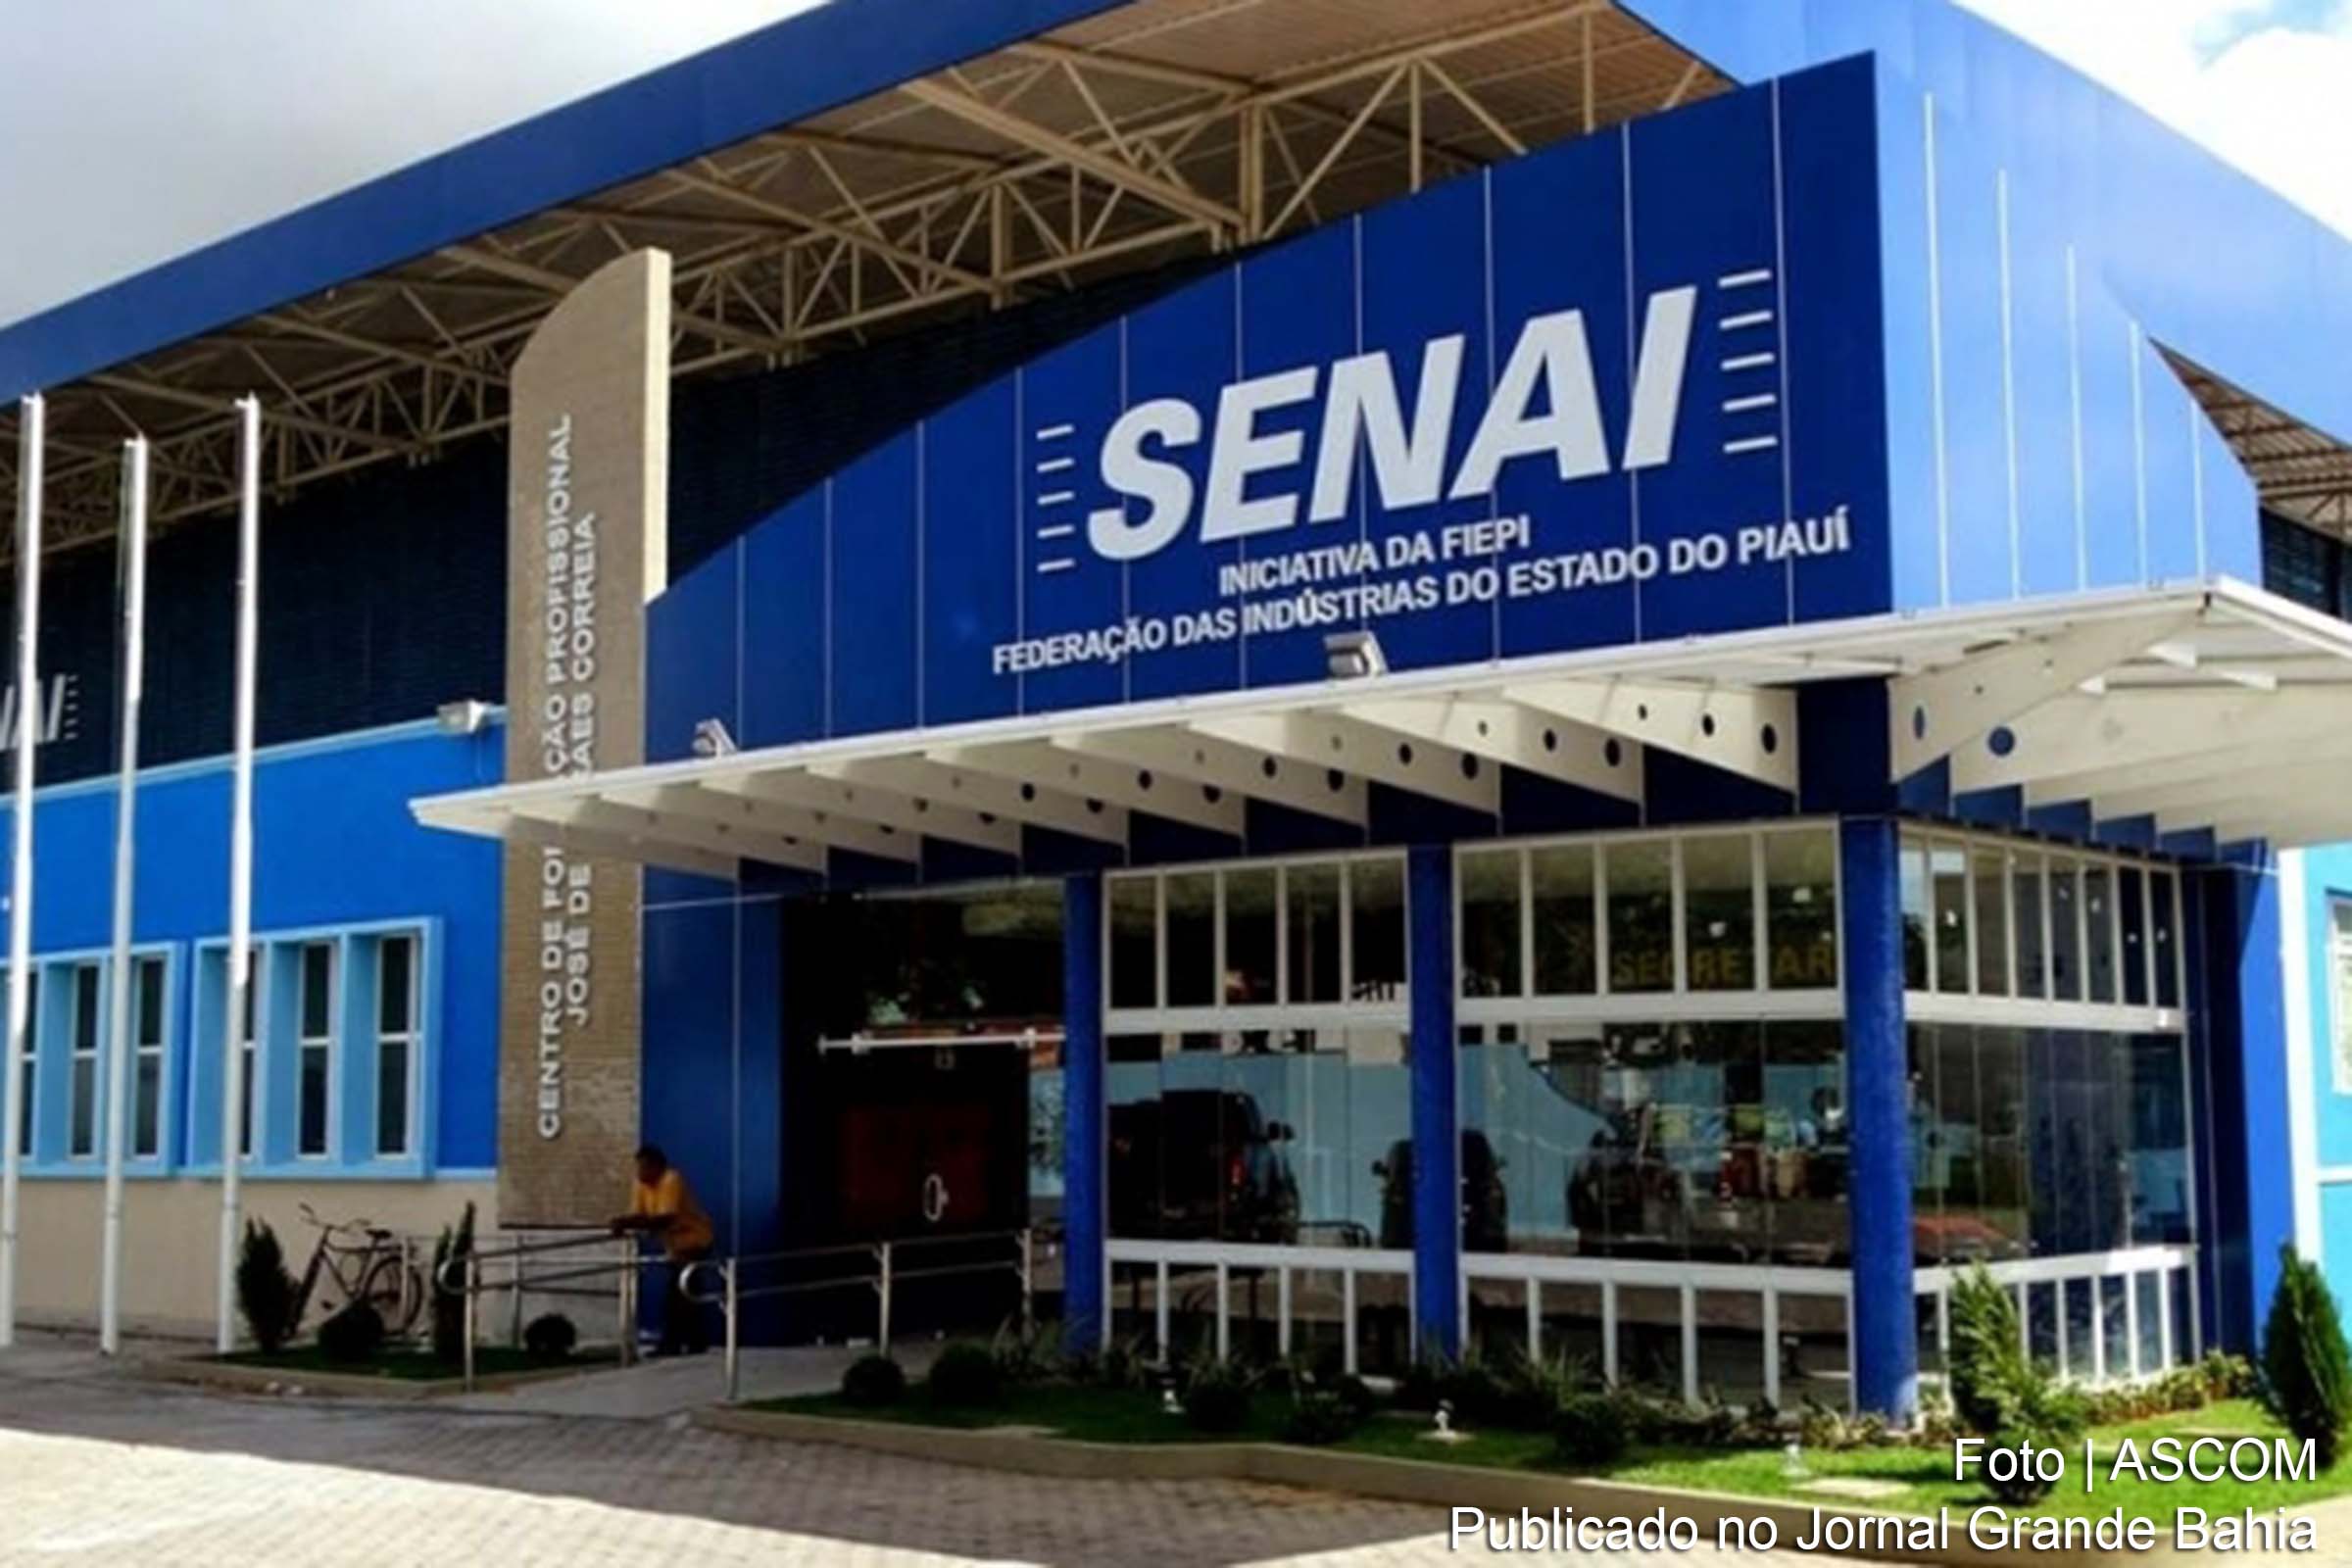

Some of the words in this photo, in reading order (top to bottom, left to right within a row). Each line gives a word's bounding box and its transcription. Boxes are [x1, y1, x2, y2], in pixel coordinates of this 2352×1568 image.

[1087, 285, 1697, 561] SENAI
[547, 413, 572, 684] PROFISSIONAL
[571, 512, 596, 683] CORREIA
[993, 616, 1166, 674] FEDERAÇÃO
[1174, 608, 1237, 648] DAS
[1242, 576, 1440, 636] INDÚSTRIAS
[1446, 566, 1499, 606] DO
[1507, 545, 1659, 598] ESTADO
[1669, 534, 1728, 574] DO
[1739, 505, 1850, 565] PIAUÍ
[1220, 540, 1378, 596] INICIATIVA
[1386, 530, 1435, 568] DA
[1442, 514, 1530, 560] FIEPI
[542, 919, 564, 970] DE
[568, 863, 591, 915] DE
[563, 926, 590, 1027] JOSÉ
[538, 980, 564, 1138] CENTRO
